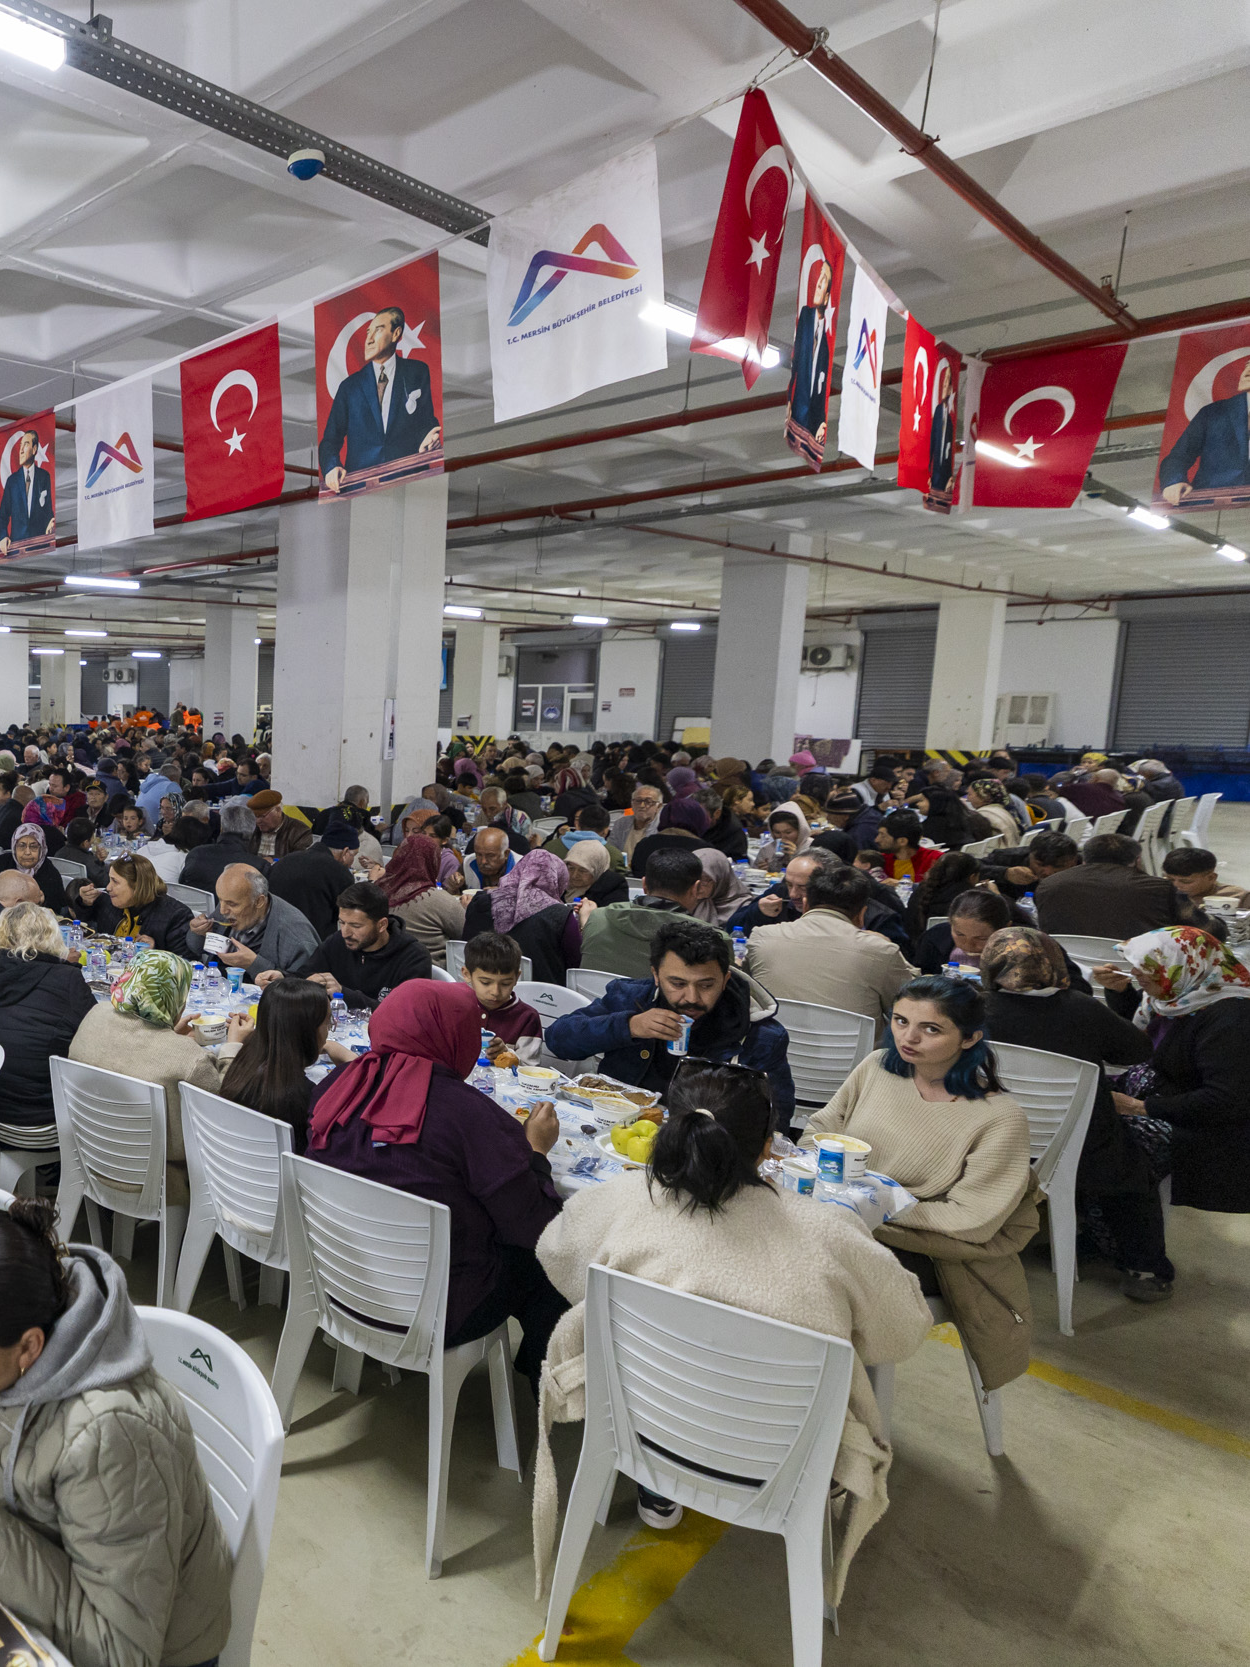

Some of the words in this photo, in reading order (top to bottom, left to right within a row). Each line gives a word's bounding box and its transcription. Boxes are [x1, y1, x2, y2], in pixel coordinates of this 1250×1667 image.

[507, 336, 520, 345] T.C.
[521, 325, 550, 341] MERSİN
[552, 304, 596, 330] BÜYÜKŞEHİR
[598, 284, 643, 308] BELEDİYESİ
